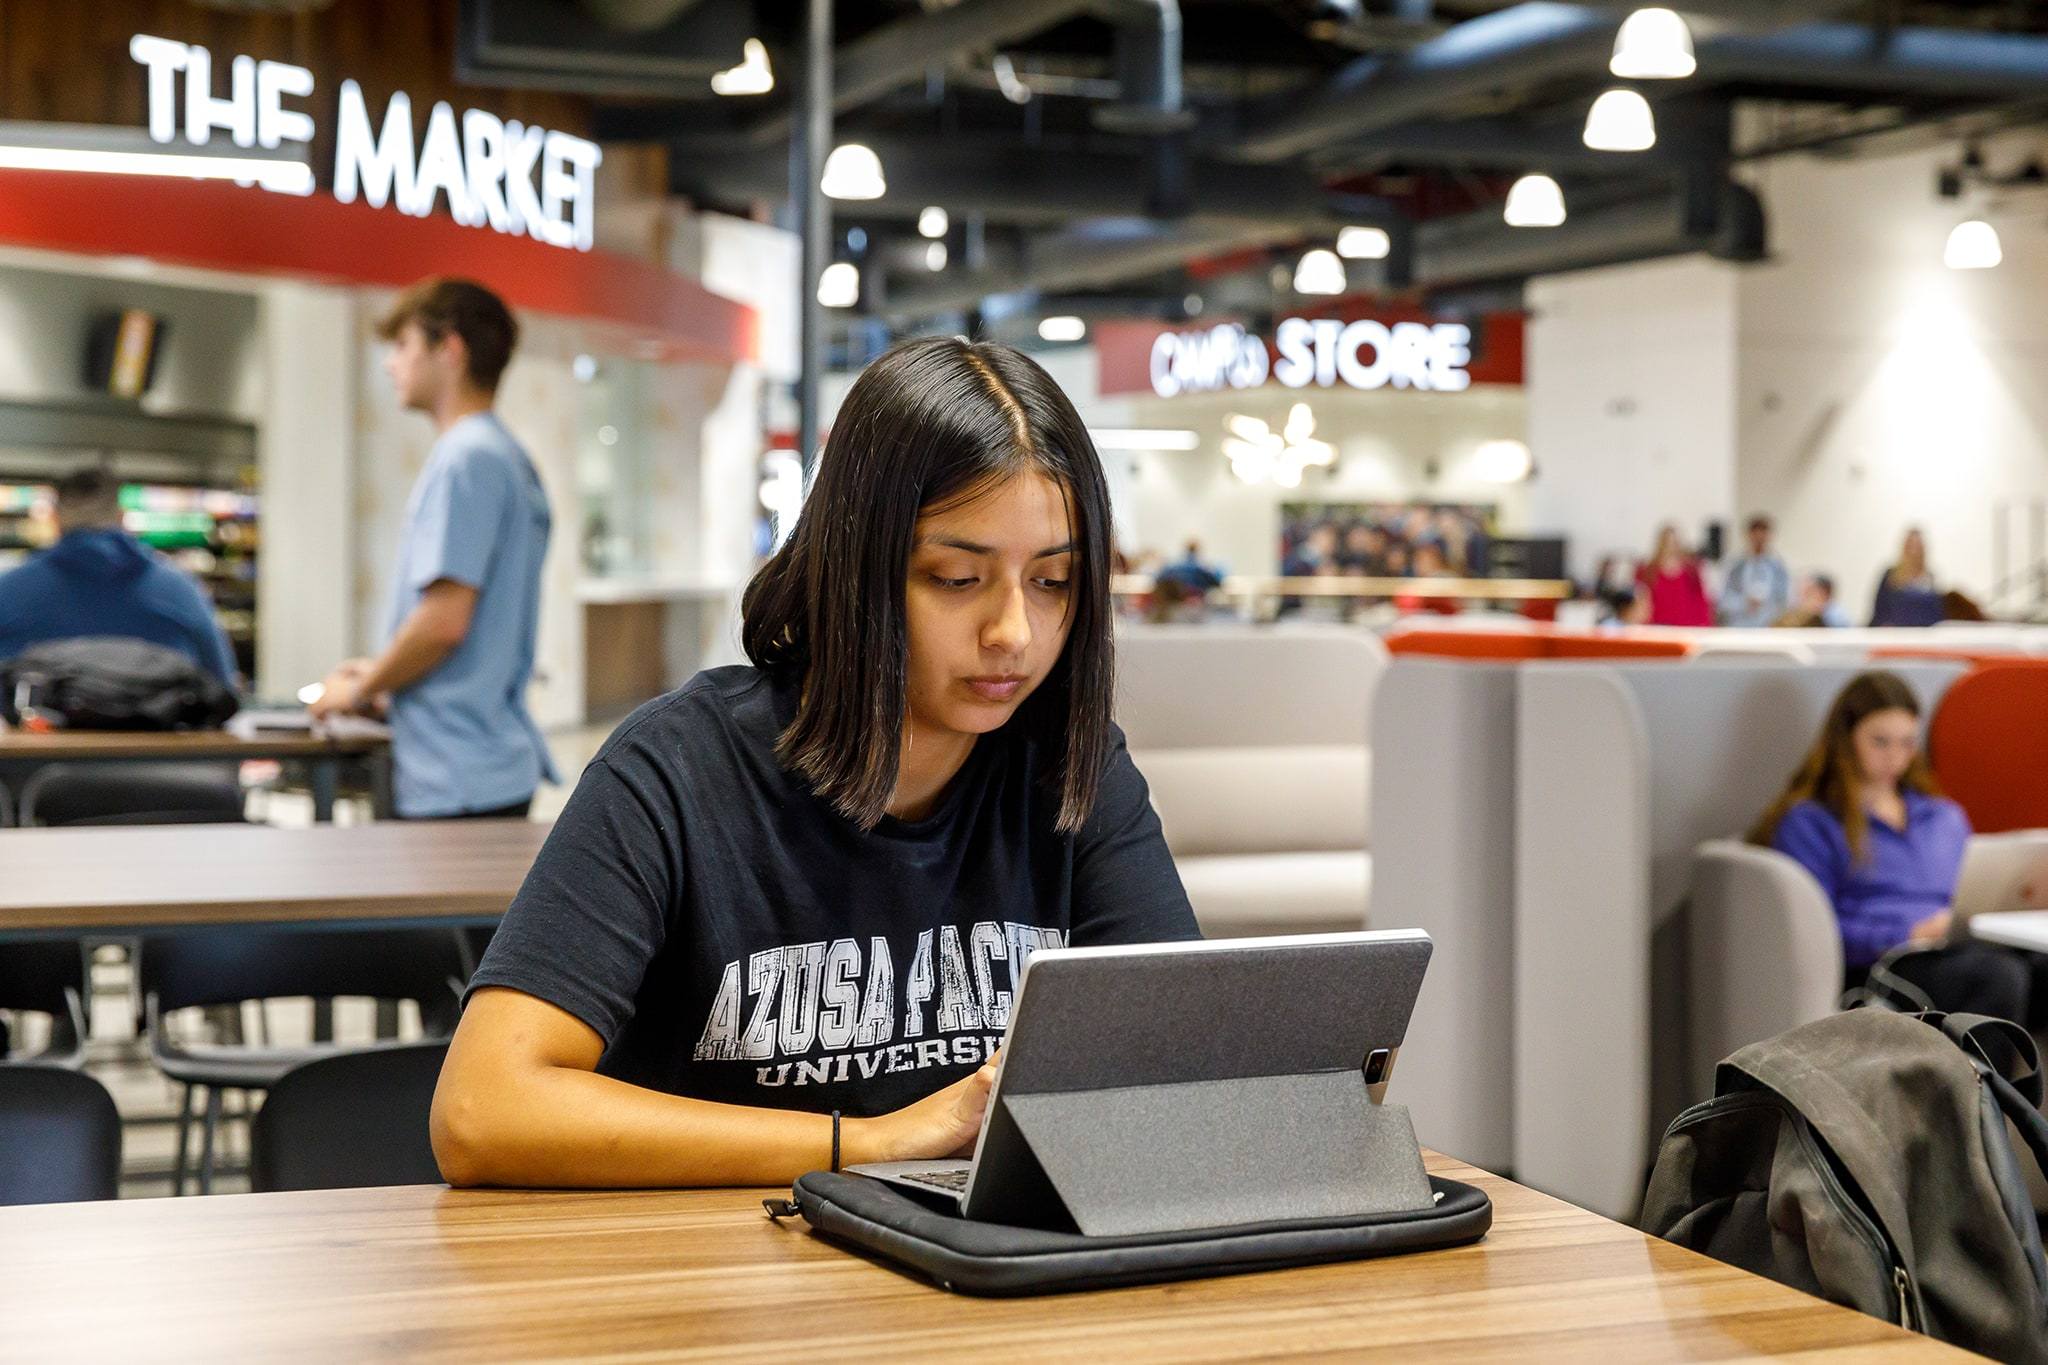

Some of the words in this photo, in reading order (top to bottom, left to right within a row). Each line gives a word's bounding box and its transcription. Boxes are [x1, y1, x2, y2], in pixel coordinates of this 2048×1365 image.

[129, 34, 316, 196] THE
[333, 78, 602, 251] MARKET
[1274, 317, 1471, 392] STORE
[692, 936, 895, 1061] AZUSA
[755, 1033, 1004, 1087] UNIVERSI
